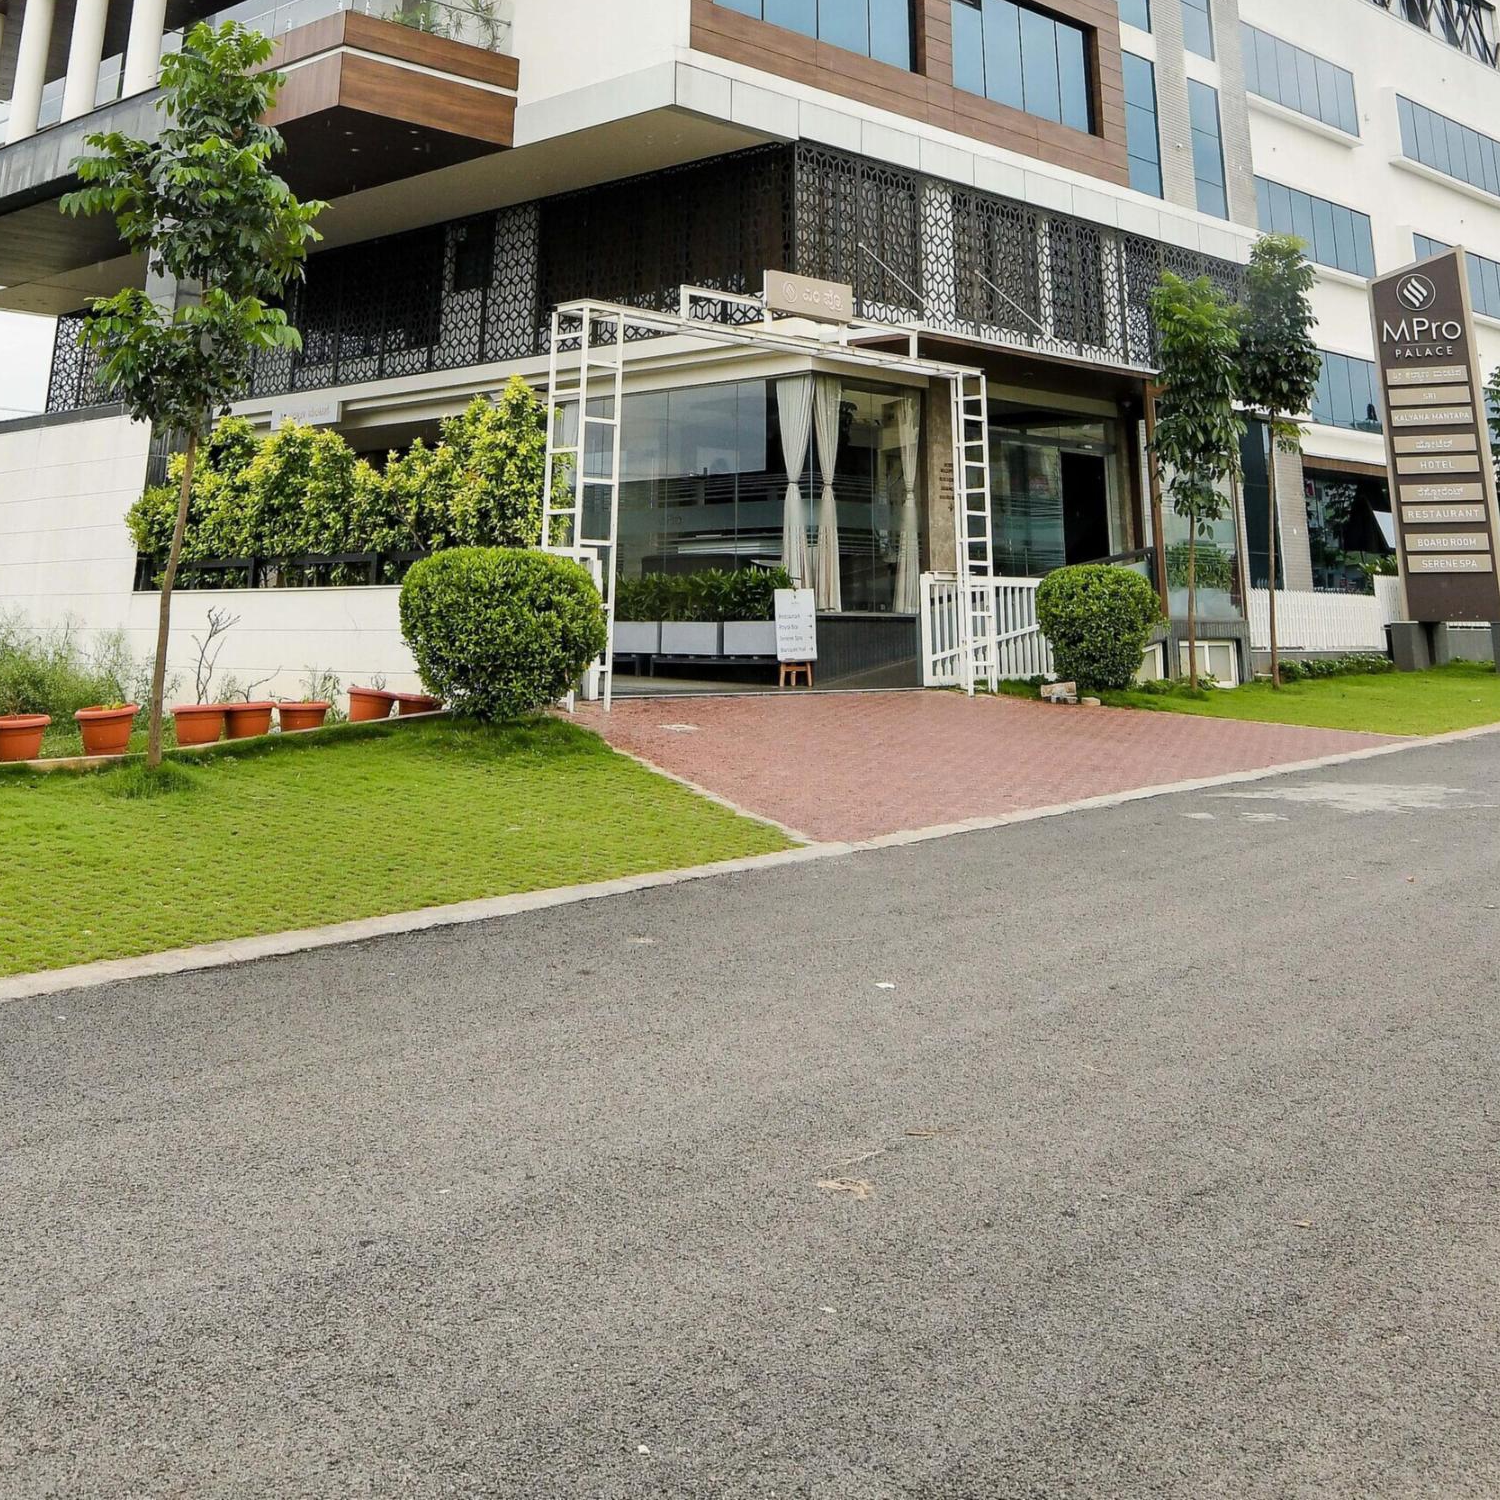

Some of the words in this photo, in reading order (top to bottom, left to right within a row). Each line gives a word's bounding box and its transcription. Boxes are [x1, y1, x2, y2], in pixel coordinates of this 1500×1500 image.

[1382, 317, 1462, 343] MPro
[1395, 346, 1453, 358] PALACE
[1394, 413, 1430, 422] KALYANA
[1431, 411, 1470, 421] MANTAPA
[1420, 460, 1455, 469] HOTEL
[1407, 508, 1480, 519] RESTAURANT
[1417, 538, 1449, 547] BOARD
[1450, 537, 1477, 547] ROOM
[1421, 559, 1458, 569] SERENE
[1459, 559, 1478, 568] SPA
